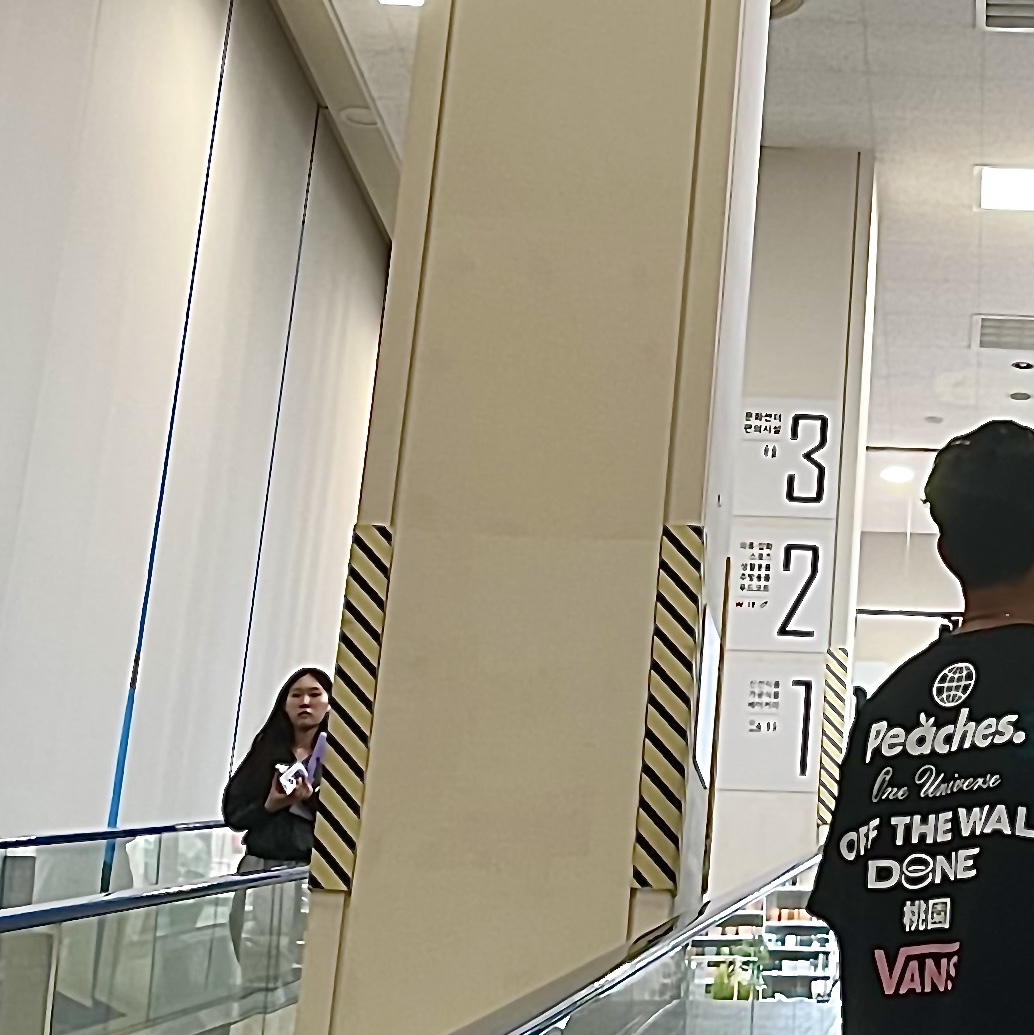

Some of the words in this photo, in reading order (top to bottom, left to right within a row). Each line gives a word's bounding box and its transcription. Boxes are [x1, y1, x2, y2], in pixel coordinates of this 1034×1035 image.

[744, 411, 782, 423] 문화센터
[744, 424, 782, 435] 편의시설
[786, 413, 829, 504] 3
[777, 543, 820, 637] 2
[792, 679, 813, 777] 1
[865, 707, 1026, 764] Peaches.
[871, 766, 909, 803] One
[914, 764, 1002, 798] Universe
[891, 811, 953, 846] THE
[867, 847, 981, 890] DONE
